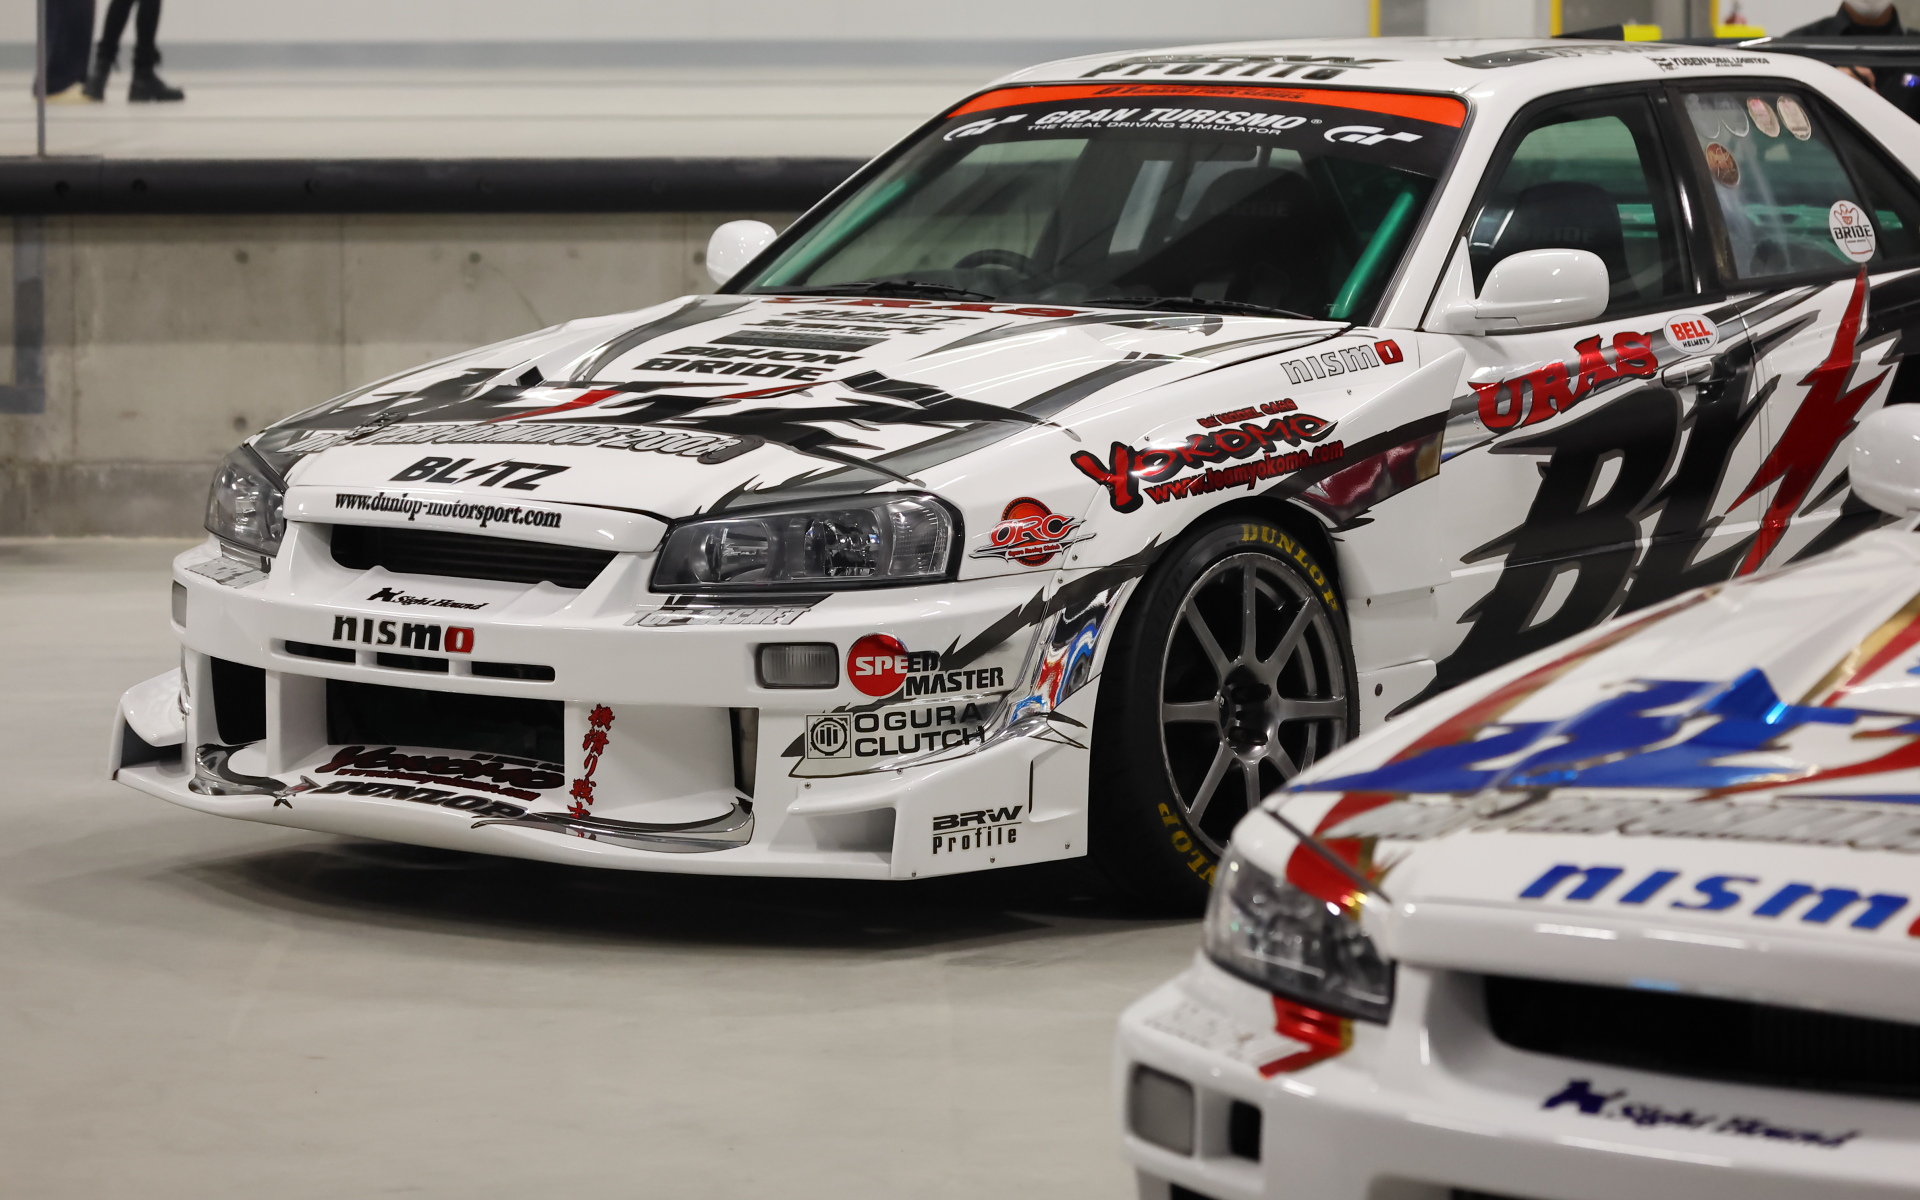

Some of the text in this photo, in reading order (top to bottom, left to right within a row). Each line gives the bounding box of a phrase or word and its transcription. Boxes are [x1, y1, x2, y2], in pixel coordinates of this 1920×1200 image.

[1670, 57, 1706, 66] YUSEN
[1035, 108, 1307, 130] GRAN TURISMO
[1179, 123, 1281, 135] SIMULATOR
[1832, 225, 1873, 240] BRIDE
[1670, 320, 1711, 341] BELL
[1682, 338, 1710, 348] HELMETS
[632, 358, 836, 382] BRIDE
[1281, 339, 1403, 385] nismo
[1466, 331, 1659, 434] URAS
[1215, 406, 1266, 424] MODEL
[1260, 398, 1298, 415] CARS
[352, 423, 641, 447] PERFORMANCE
[597, 429, 744, 458] 2008
[1070, 413, 1338, 514] YOKOMO
[1143, 440, 1344, 504] www.teamyokomo.com
[334, 490, 562, 528] www.dunlop-motorsport.com
[990, 514, 1076, 547] ORC
[1241, 523, 1339, 612] DUNLOP
[623, 607, 812, 628] TOP SECRET
[332, 614, 475, 654] nismo
[855, 650, 940, 676] SPEED
[904, 666, 1004, 698] MASTER
[854, 703, 984, 733] OGURA
[854, 725, 986, 757] CLUTCH
[306, 781, 529, 820] DUNLOP
[932, 805, 1023, 831] BRW
[1157, 801, 1219, 888] NLOP
[1518, 862, 1920, 938] nism
